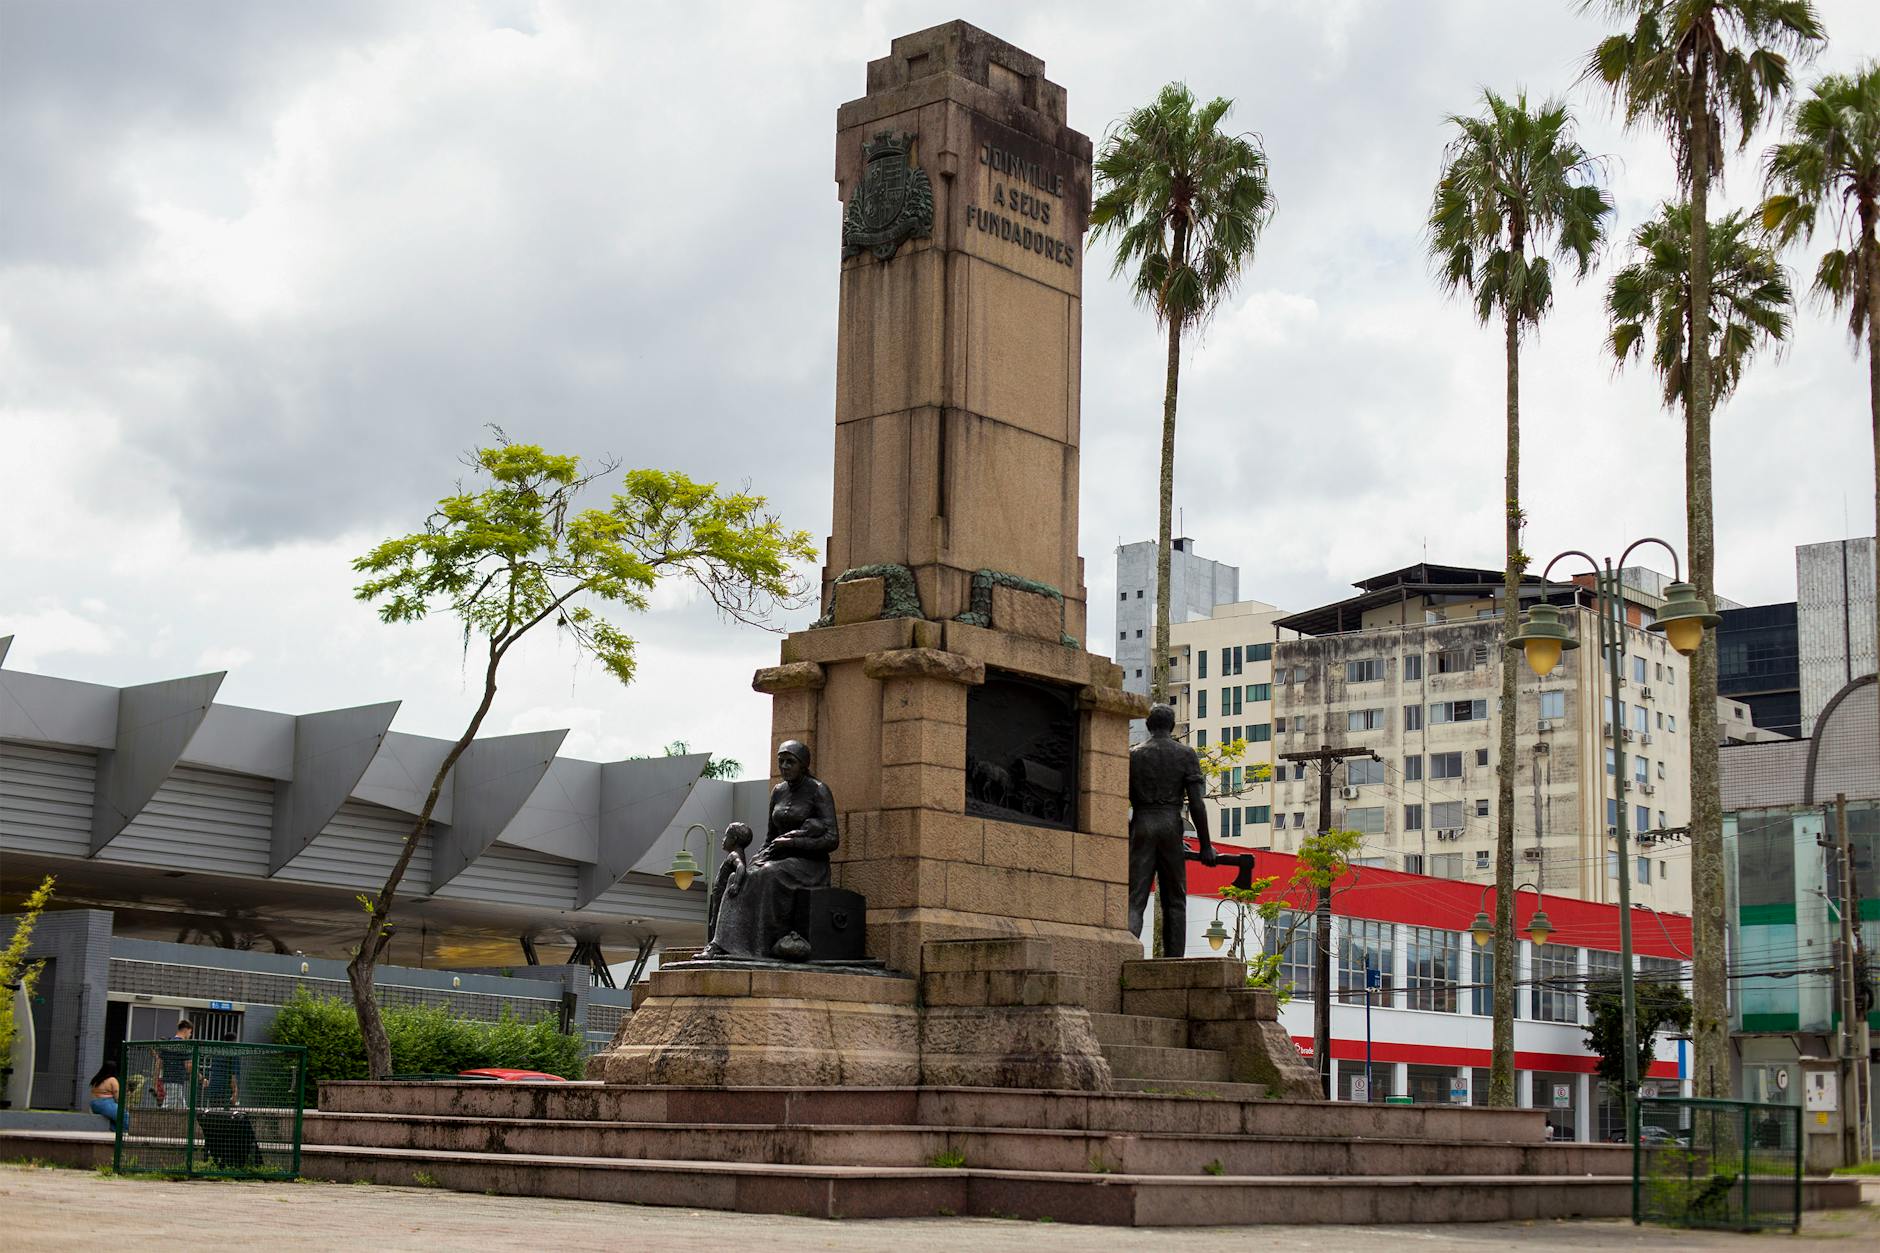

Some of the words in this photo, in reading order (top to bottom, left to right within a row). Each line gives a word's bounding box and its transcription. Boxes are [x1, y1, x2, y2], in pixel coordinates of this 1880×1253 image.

[980, 143, 1064, 199] JOINVILLE
[993, 182, 1005, 207] A
[1009, 188, 1051, 225] SEUS
[967, 205, 1074, 267] FUNDADORES
